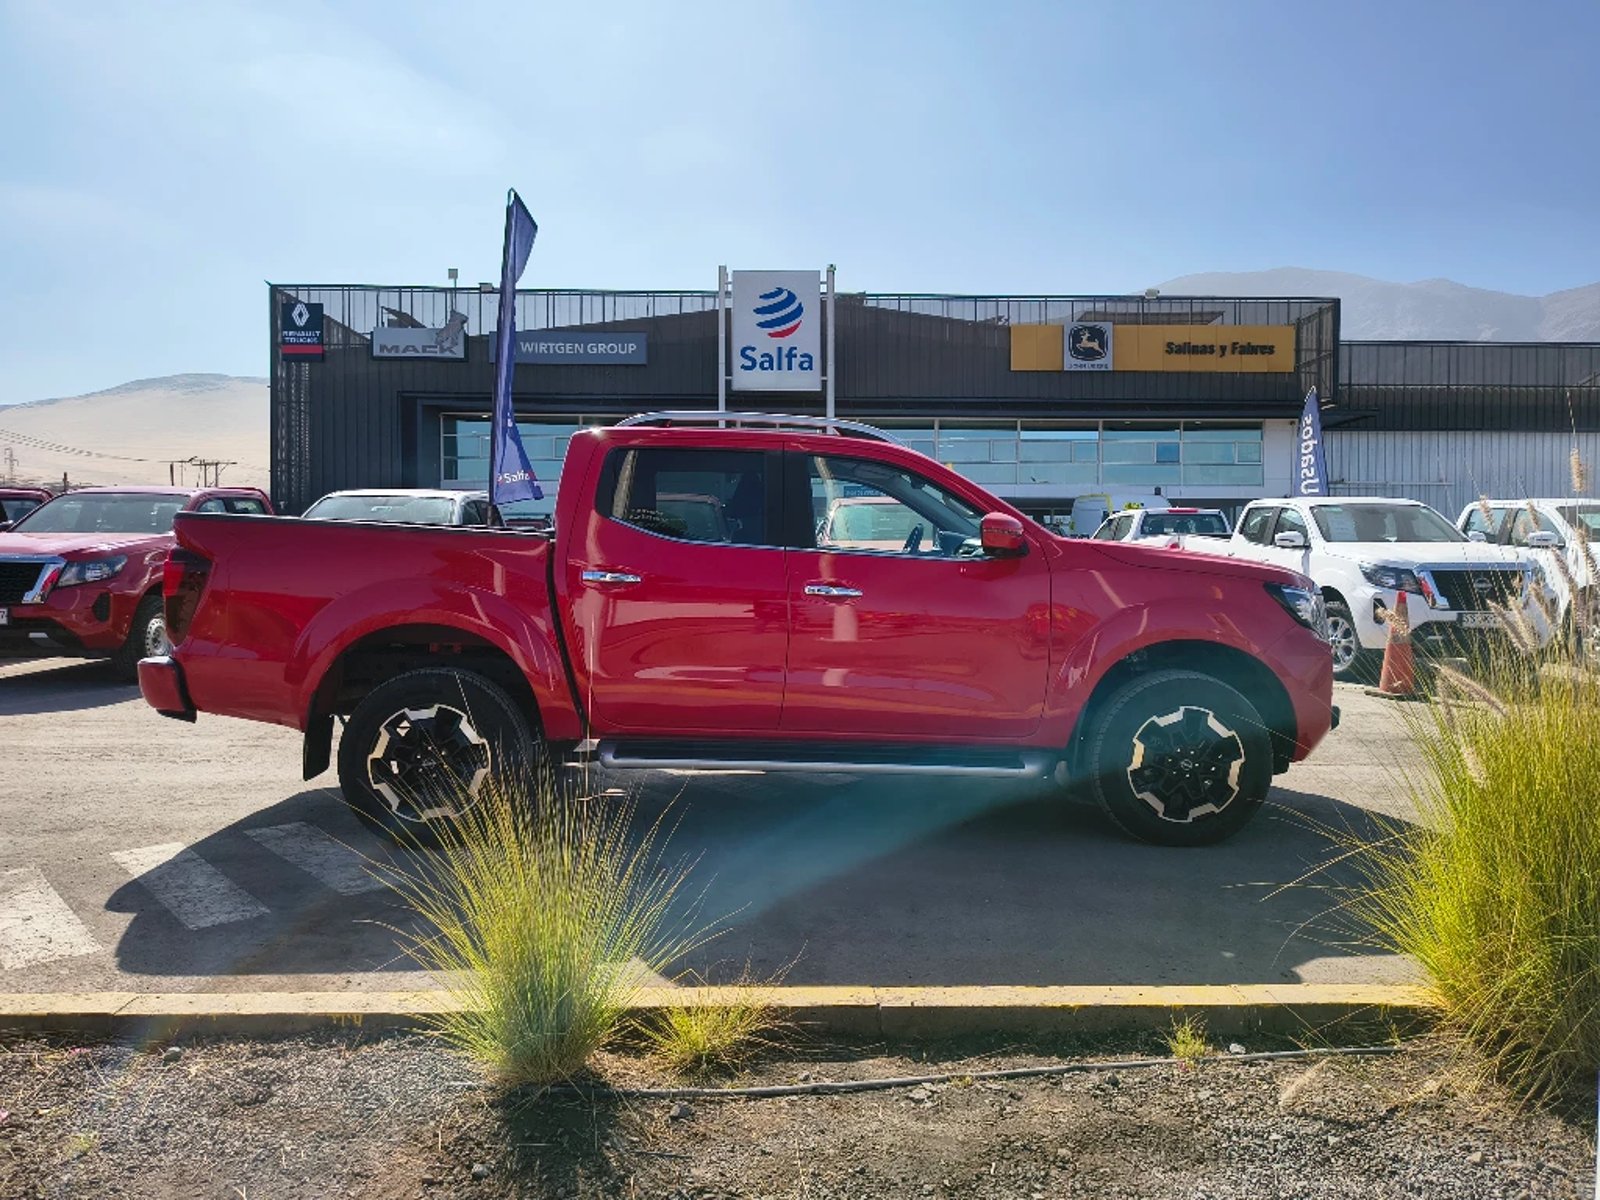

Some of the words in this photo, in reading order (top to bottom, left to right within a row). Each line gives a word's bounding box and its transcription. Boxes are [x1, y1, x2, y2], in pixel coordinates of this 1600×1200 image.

[379, 343, 456, 355] MACK
[519, 341, 584, 354] WIRTGEN
[587, 343, 637, 355] GROUP
[1165, 341, 1216, 355] Salinas
[1219, 344, 1227, 358] y
[1231, 341, 1275, 355] Fabres
[740, 345, 814, 371] Salfa
